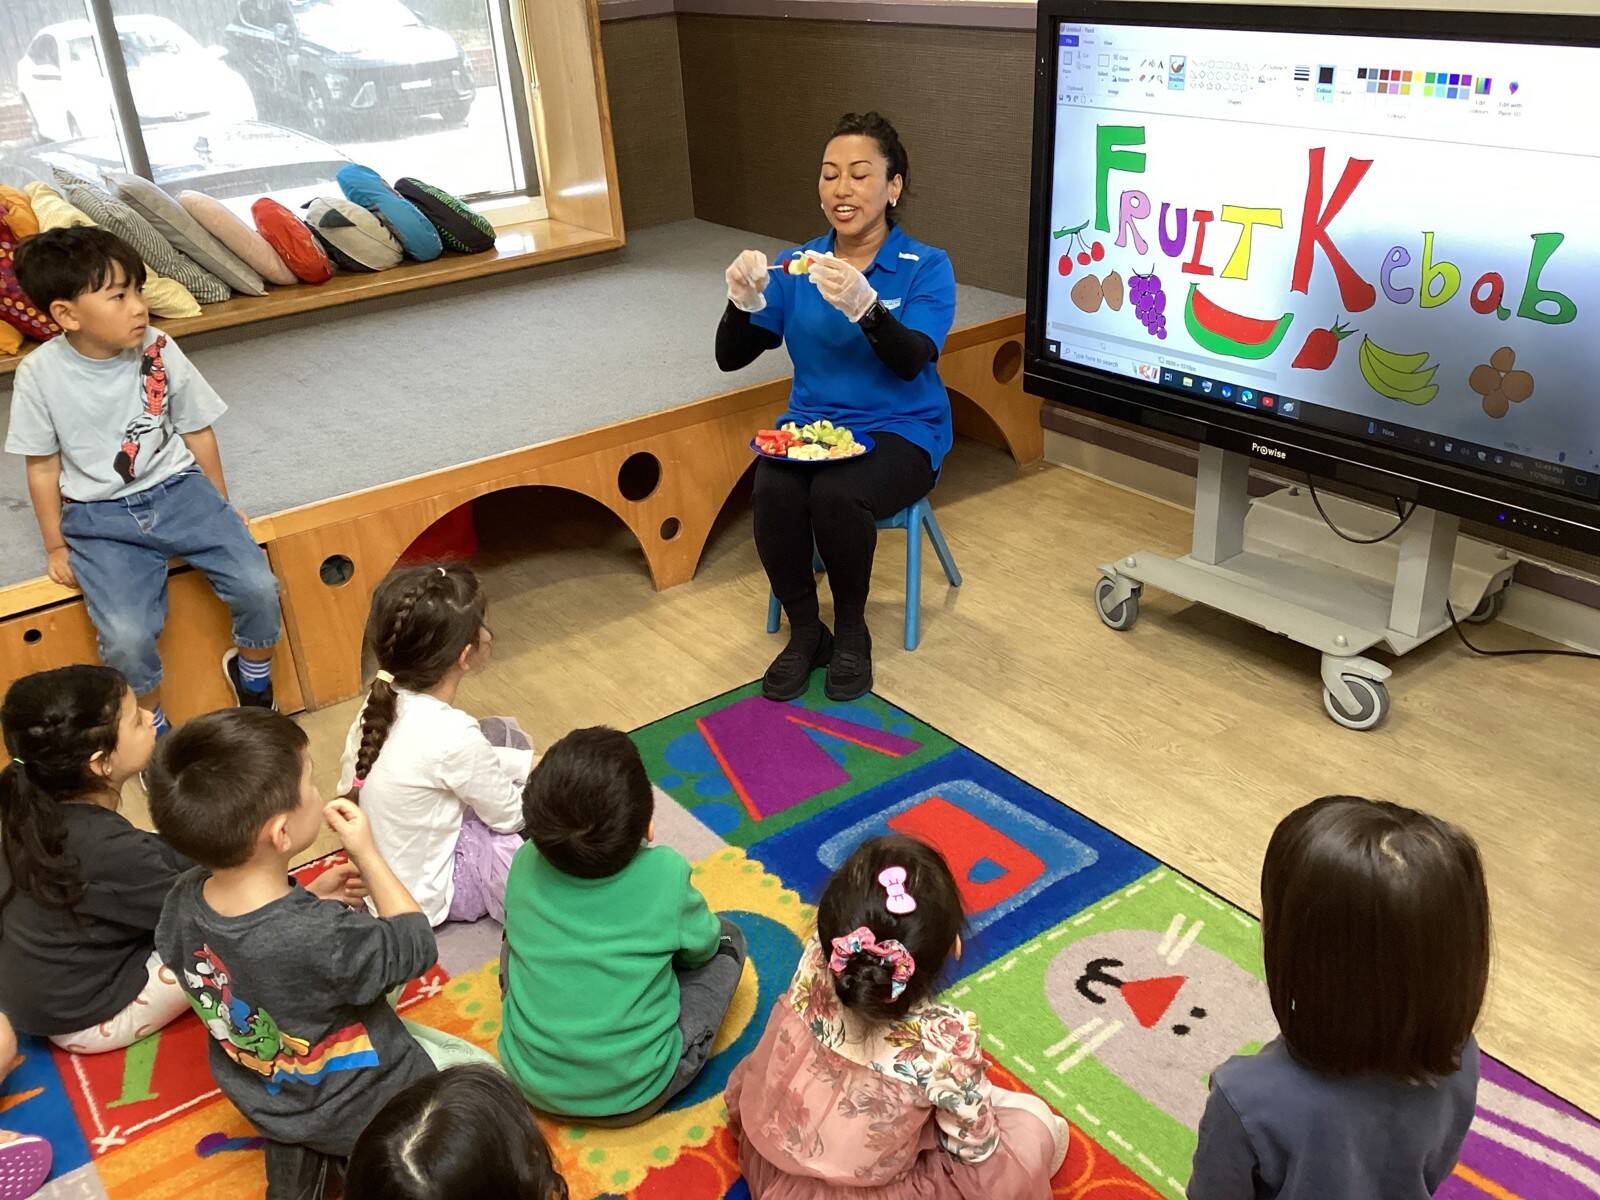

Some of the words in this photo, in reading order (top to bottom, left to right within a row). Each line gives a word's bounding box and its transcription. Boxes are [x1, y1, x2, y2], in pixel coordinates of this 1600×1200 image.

[1095, 124, 1283, 280] FRUIT
[1290, 147, 1577, 324] Kebab
[1251, 441, 1287, 460] Prowise
